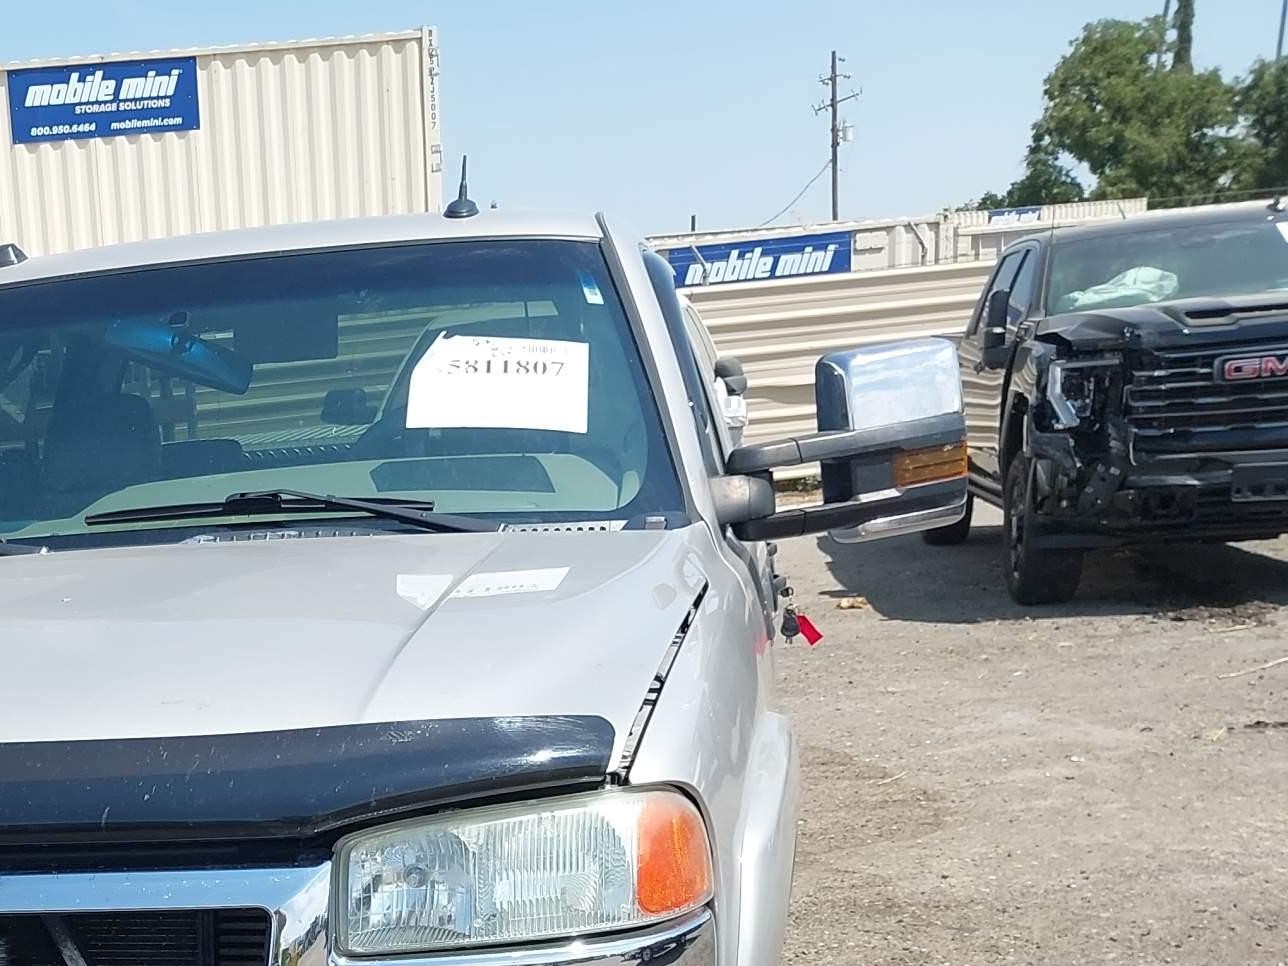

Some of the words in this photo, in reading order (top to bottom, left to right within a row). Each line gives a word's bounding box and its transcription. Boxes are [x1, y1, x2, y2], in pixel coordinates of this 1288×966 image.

[24, 70, 116, 107] mobile
[119, 69, 180, 99] mini
[74, 100, 117, 114] STORAGE
[118, 98, 171, 111] SOLUTIONS
[30, 122, 96, 136] 800.950.6464
[111, 117, 183, 130] mobilemini.com
[684, 247, 774, 286] mobile
[775, 244, 835, 277] mini
